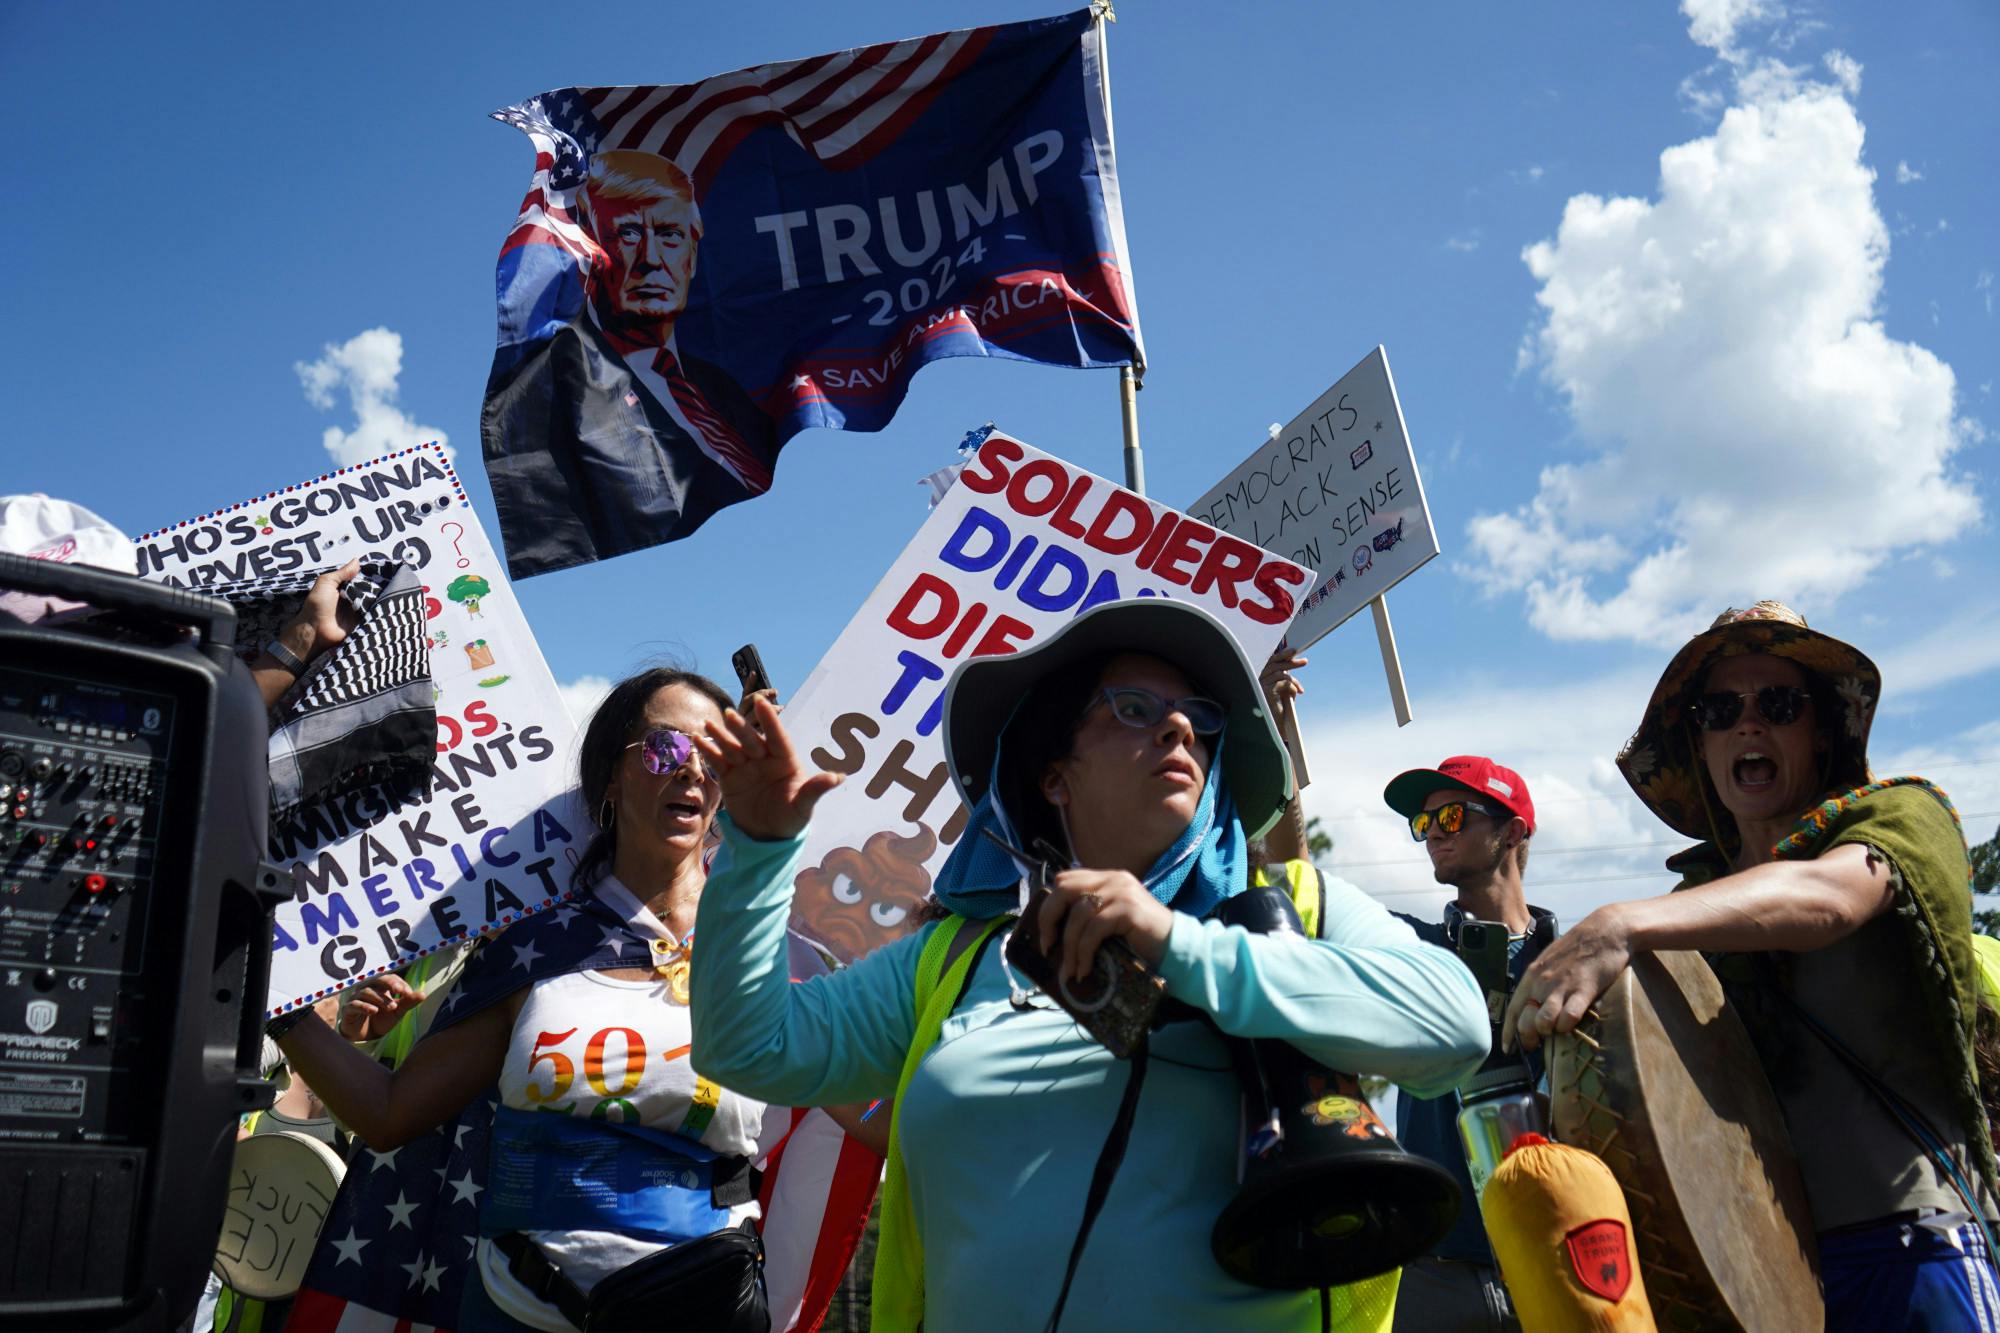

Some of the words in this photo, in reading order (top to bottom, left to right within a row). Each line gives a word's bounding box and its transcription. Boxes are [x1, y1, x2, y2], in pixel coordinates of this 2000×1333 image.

[755, 129, 1064, 291] TRUMP
[822, 347, 904, 390] SAVE
[907, 276, 1064, 345] AMERICA
[269, 456, 447, 530] GONNA
[352, 499, 423, 544] UR
[960, 437, 1305, 625] SOLDIERS
[1254, 463, 1338, 548] LACK
[1332, 467, 1403, 546] SENSE
[271, 808, 573, 952] AMERICA
[291, 793, 489, 903] MAKE
[319, 856, 561, 981] GREAT
